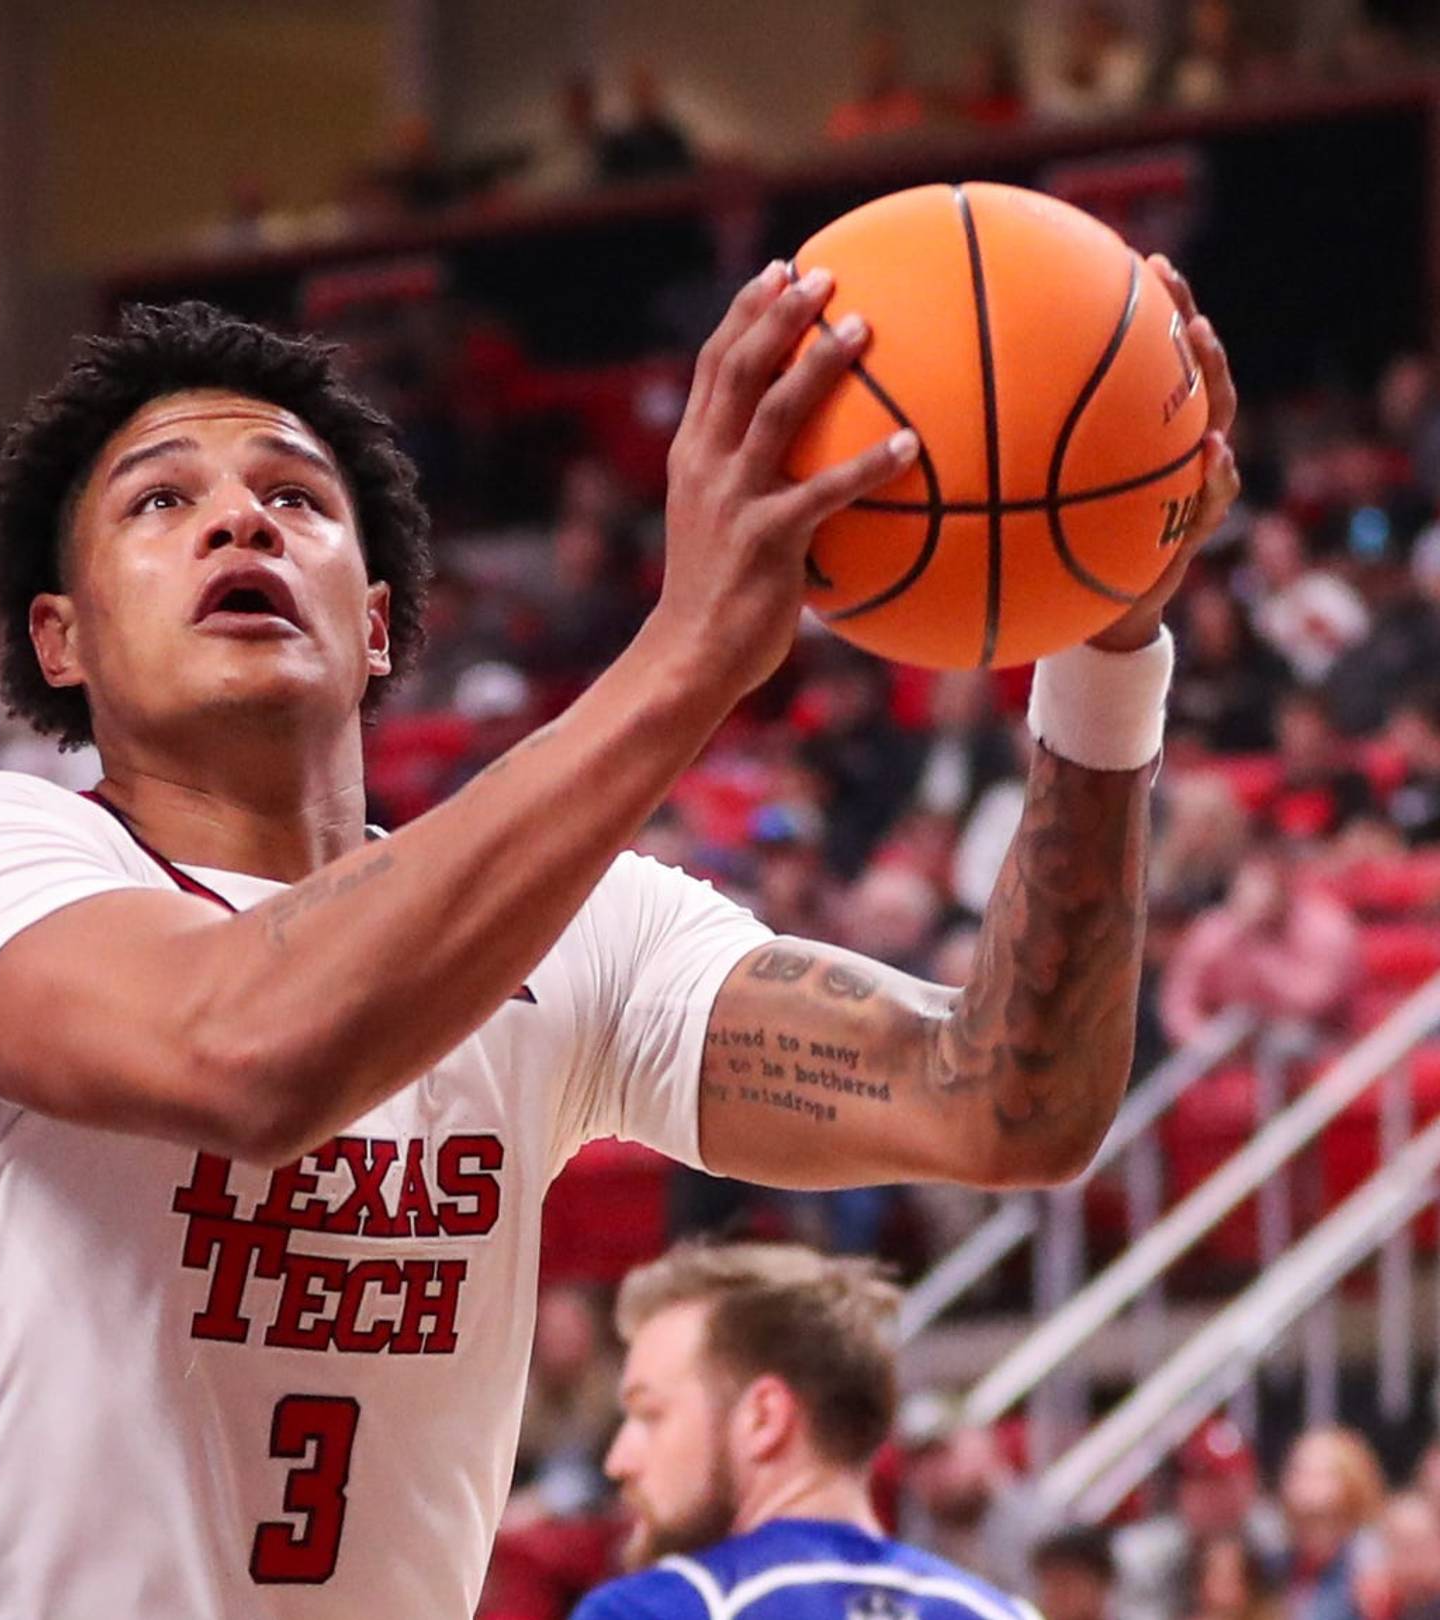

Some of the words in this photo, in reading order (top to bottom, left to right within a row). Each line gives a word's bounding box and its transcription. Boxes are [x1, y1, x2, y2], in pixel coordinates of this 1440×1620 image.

[810, 1040, 859, 1070] many
[762, 1057, 785, 1078] be
[795, 1063, 891, 1102] bothered
[739, 1085, 838, 1122] raindrops
[181, 1212, 468, 1354] TECH
[248, 1393, 360, 1585] 3
